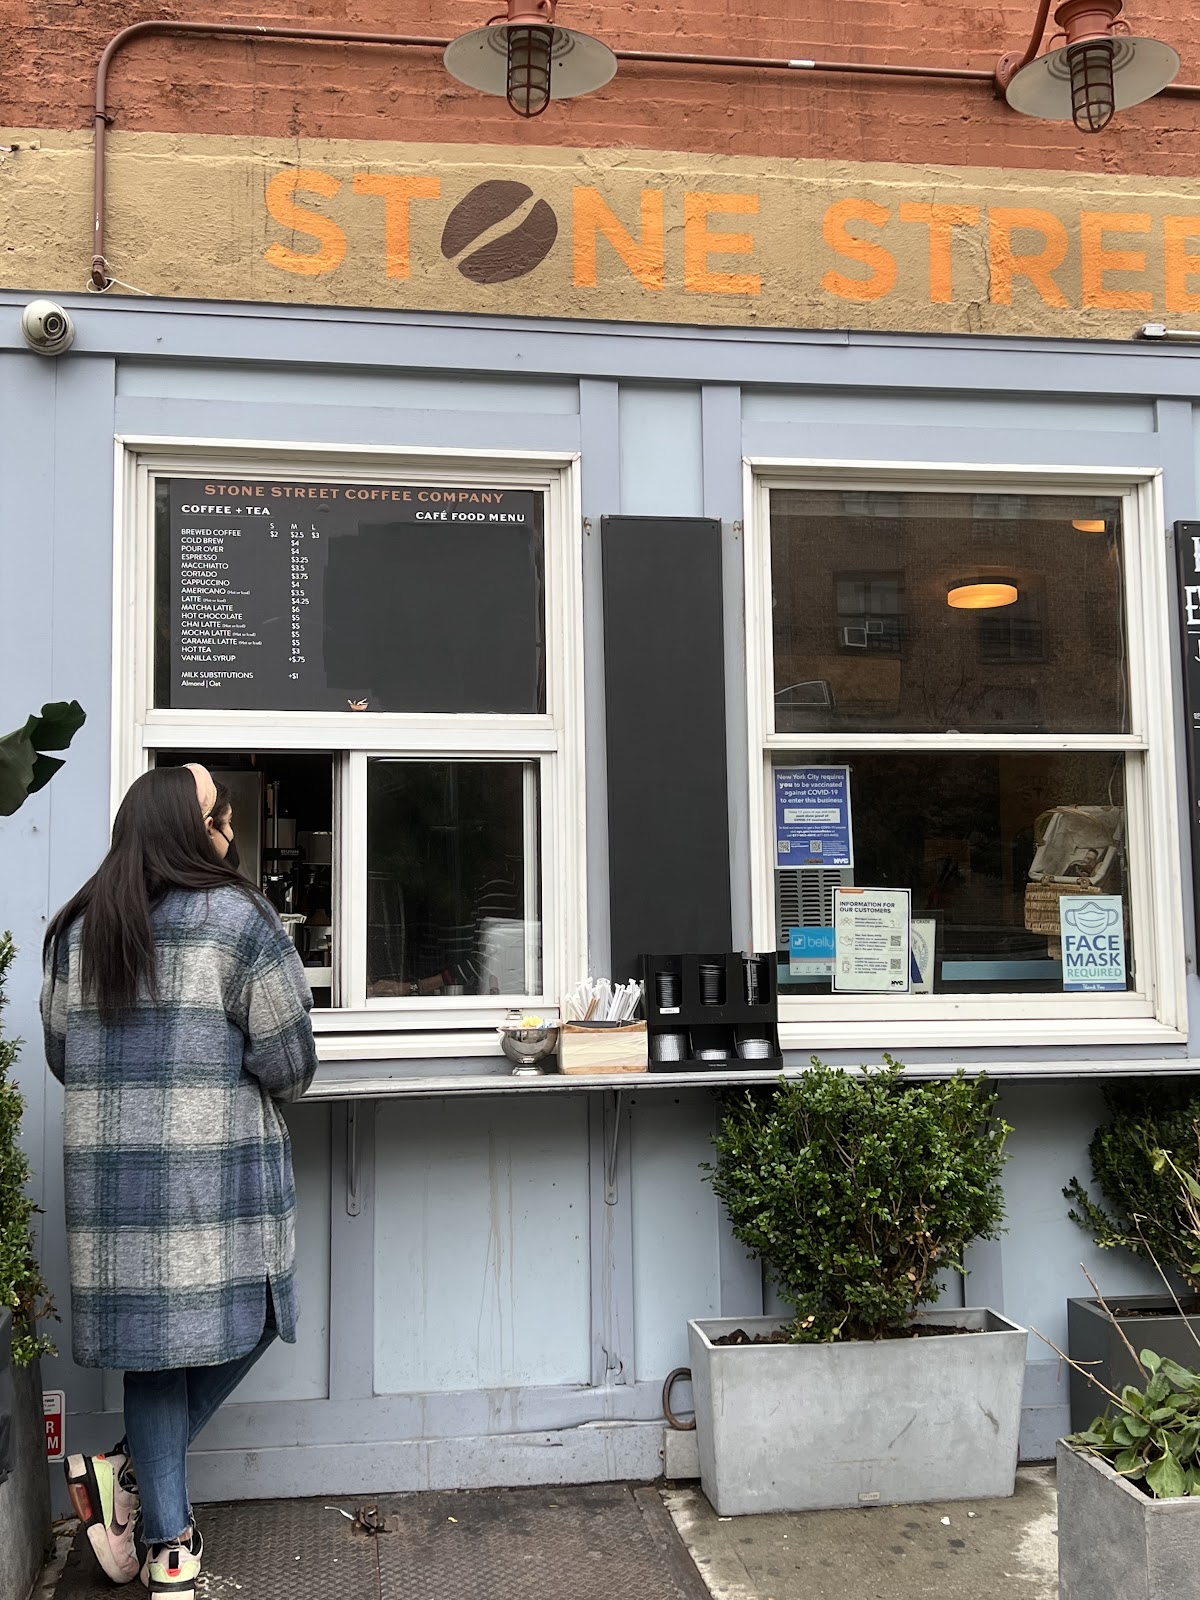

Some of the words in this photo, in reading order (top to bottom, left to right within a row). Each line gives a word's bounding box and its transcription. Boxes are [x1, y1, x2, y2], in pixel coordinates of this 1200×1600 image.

[204, 484, 265, 497] STONE
[271, 487, 339, 499] STREET
[345, 489, 412, 501] COFFEE
[418, 491, 504, 504] COMPANY
[181, 504, 231, 514] COFFEE
[246, 507, 270, 515] TEA
[415, 510, 447, 520] CAFÉ
[452, 512, 485, 521] FOOD
[489, 513, 525, 522] MENU
[181, 528, 212, 536] BREWED
[291, 539, 299, 547] $4
[291, 564, 305, 572] $3.5
[808, 936, 834, 949] belly
[1065, 935, 1120, 951] FACE
[1067, 953, 1121, 966] MASK
[1067, 968, 1122, 978] REQUIRED
